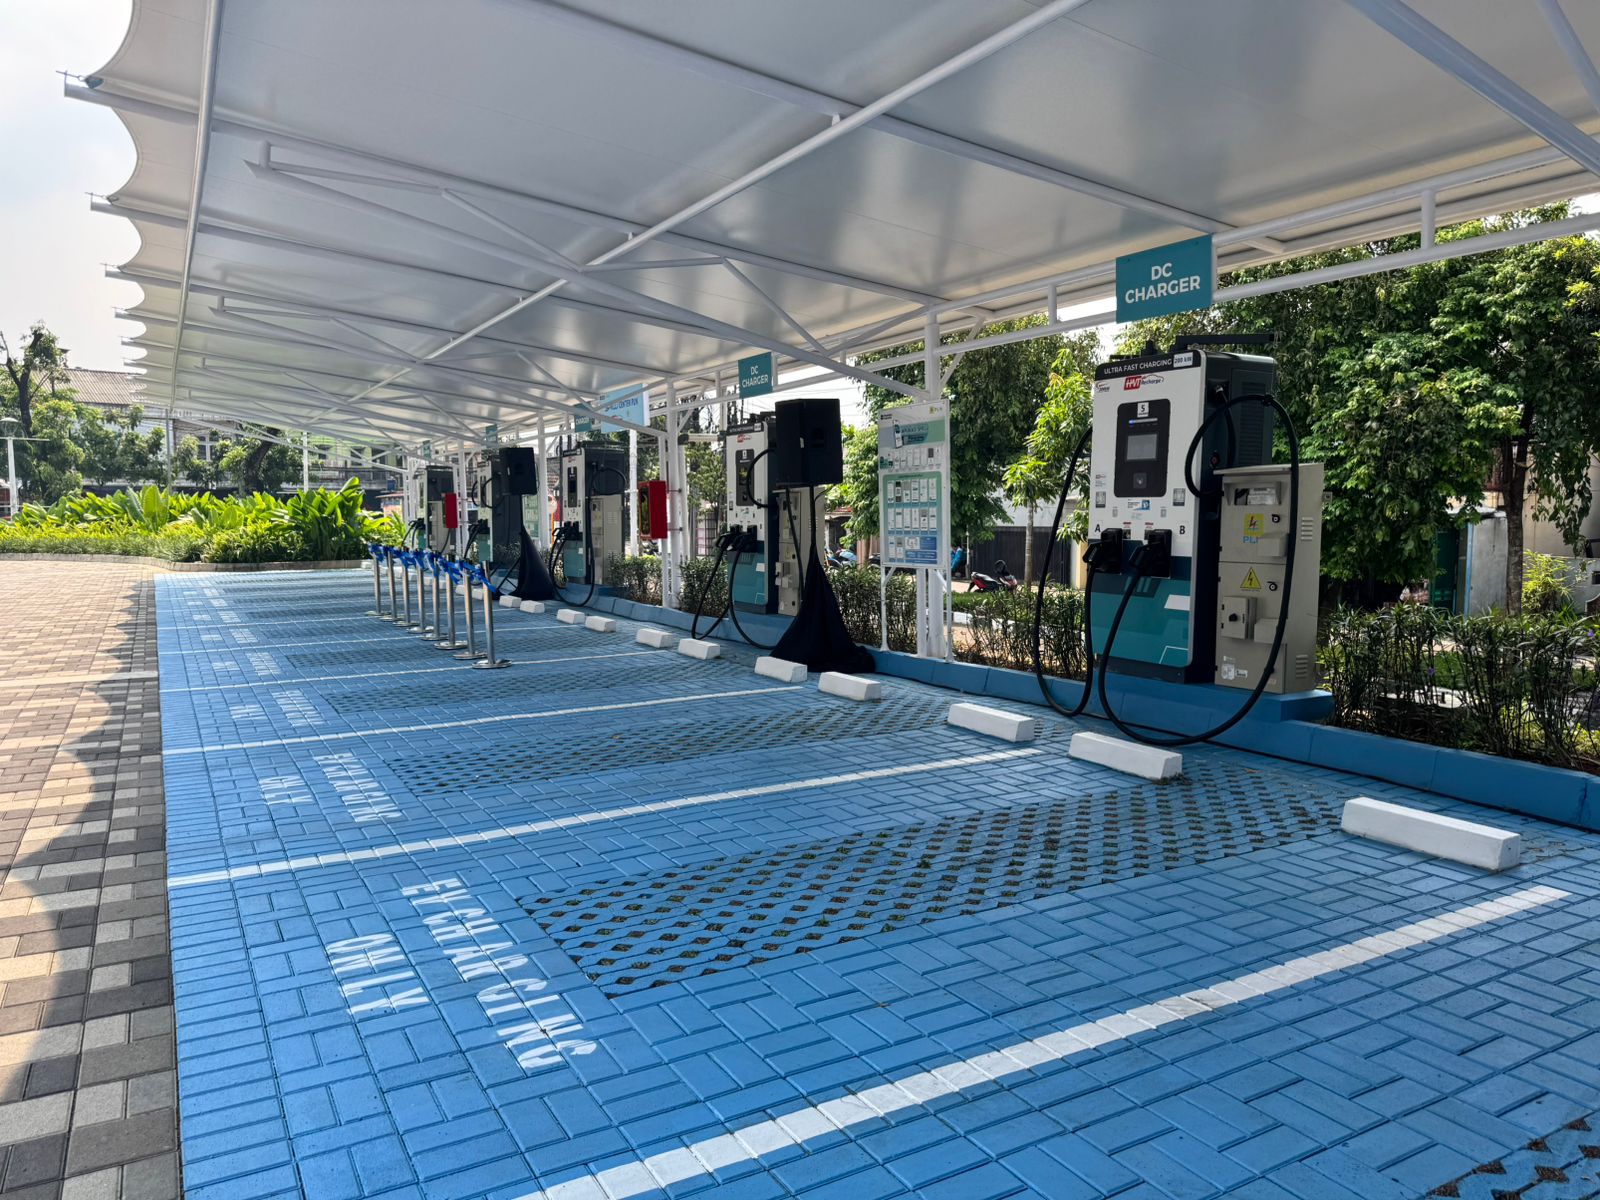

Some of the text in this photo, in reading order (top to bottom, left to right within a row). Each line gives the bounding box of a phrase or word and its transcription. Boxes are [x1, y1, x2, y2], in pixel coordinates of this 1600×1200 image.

[1151, 262, 1172, 281] DC
[1125, 275, 1200, 304] CHARGER
[750, 365, 759, 375] DC
[1104, 366, 1123, 375] ULTRA
[1123, 363, 1139, 372] FAST
[1139, 358, 1172, 369] CHARGING
[741, 374, 769, 388] CHARGER
[1140, 404, 1146, 412] 5
[1095, 523, 1101, 533] A
[1179, 525, 1186, 535] B
[325, 933, 430, 1016] ONLY
[400, 878, 597, 1071] EV CHARGING
